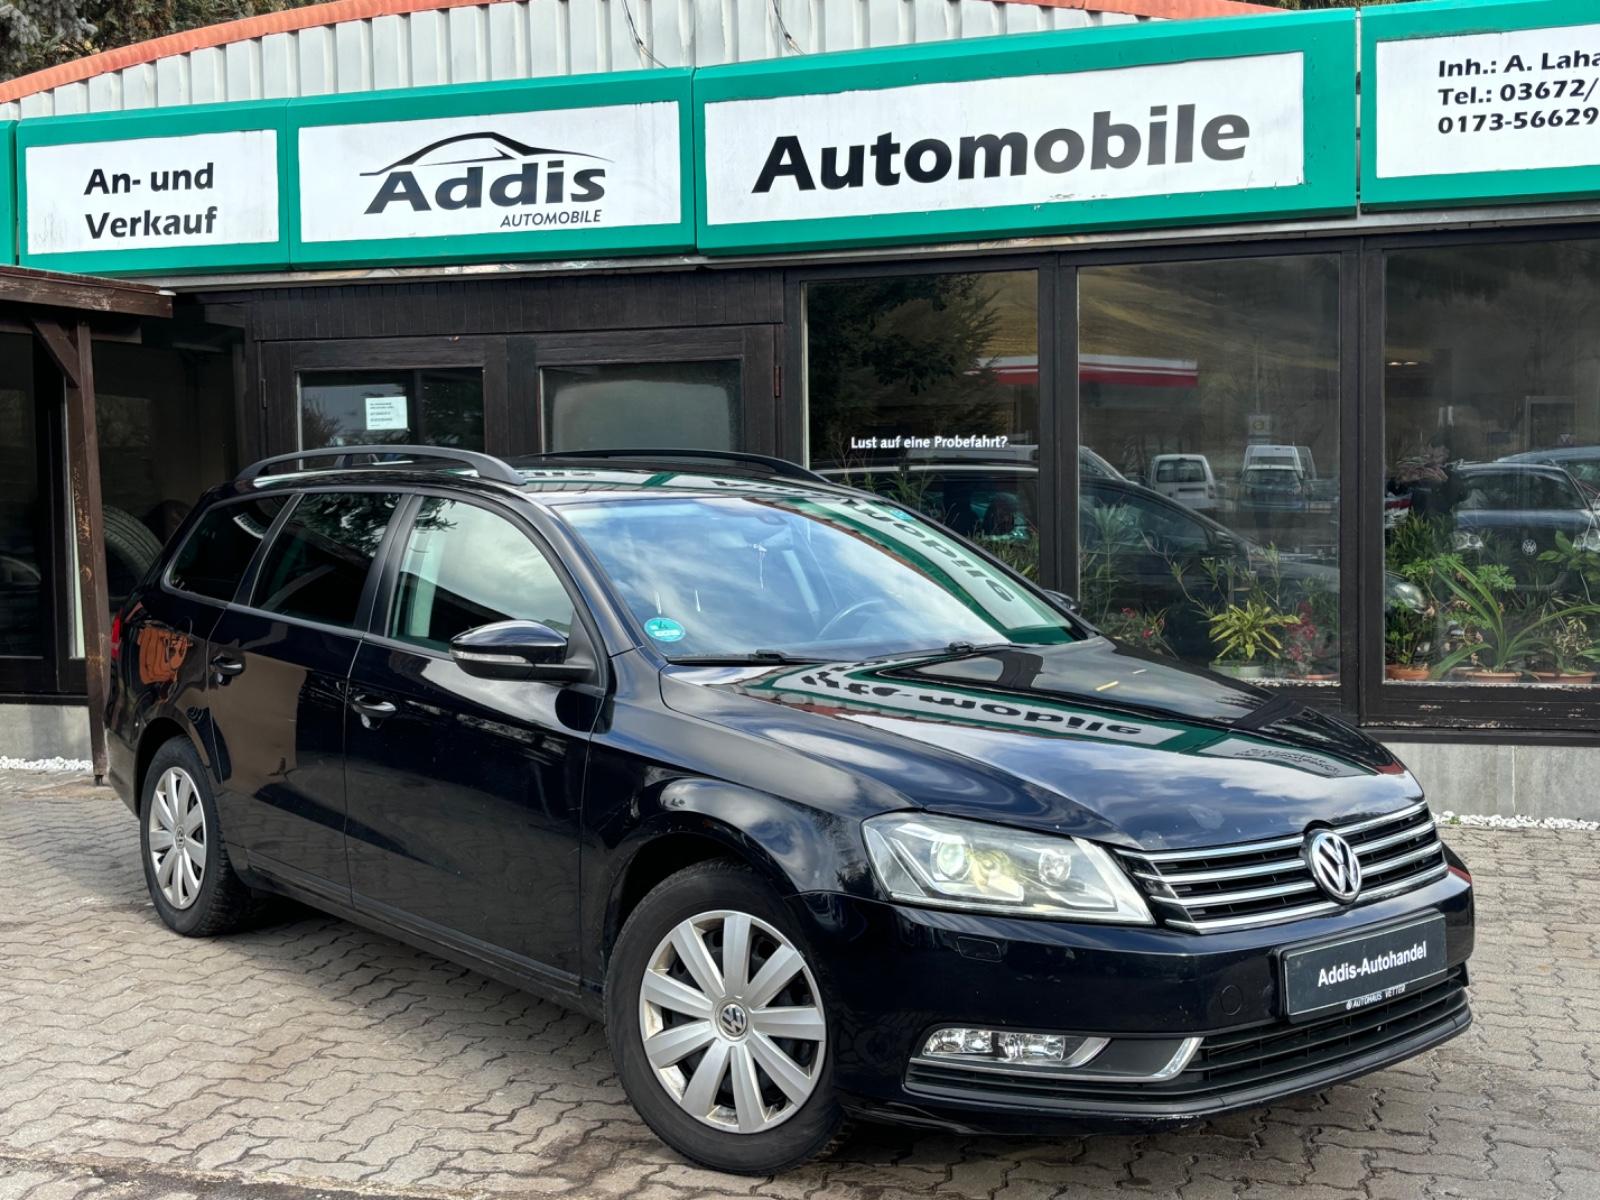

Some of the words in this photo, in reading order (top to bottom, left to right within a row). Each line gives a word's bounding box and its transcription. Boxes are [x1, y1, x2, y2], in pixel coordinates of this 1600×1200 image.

[1438, 57, 1497, 78] Inh.:
[1503, 54, 1533, 73] A.
[1438, 86, 1492, 106] Tel.:
[1499, 77, 1599, 102] 03672/
[1438, 107, 1599, 134] 0173-56629
[751, 104, 1251, 194] Automobile
[84, 168, 141, 196] An-
[151, 162, 214, 192] und
[364, 159, 606, 215] Addis
[86, 205, 218, 240] Verkauf
[500, 209, 603, 228] AUTOMOBILE
[851, 436, 877, 449] Lust
[880, 435, 902, 449] auf
[904, 435, 931, 449] eine
[933, 434, 1008, 449] Probefahrt?
[1317, 940, 1427, 988] Addis-Autohandel
